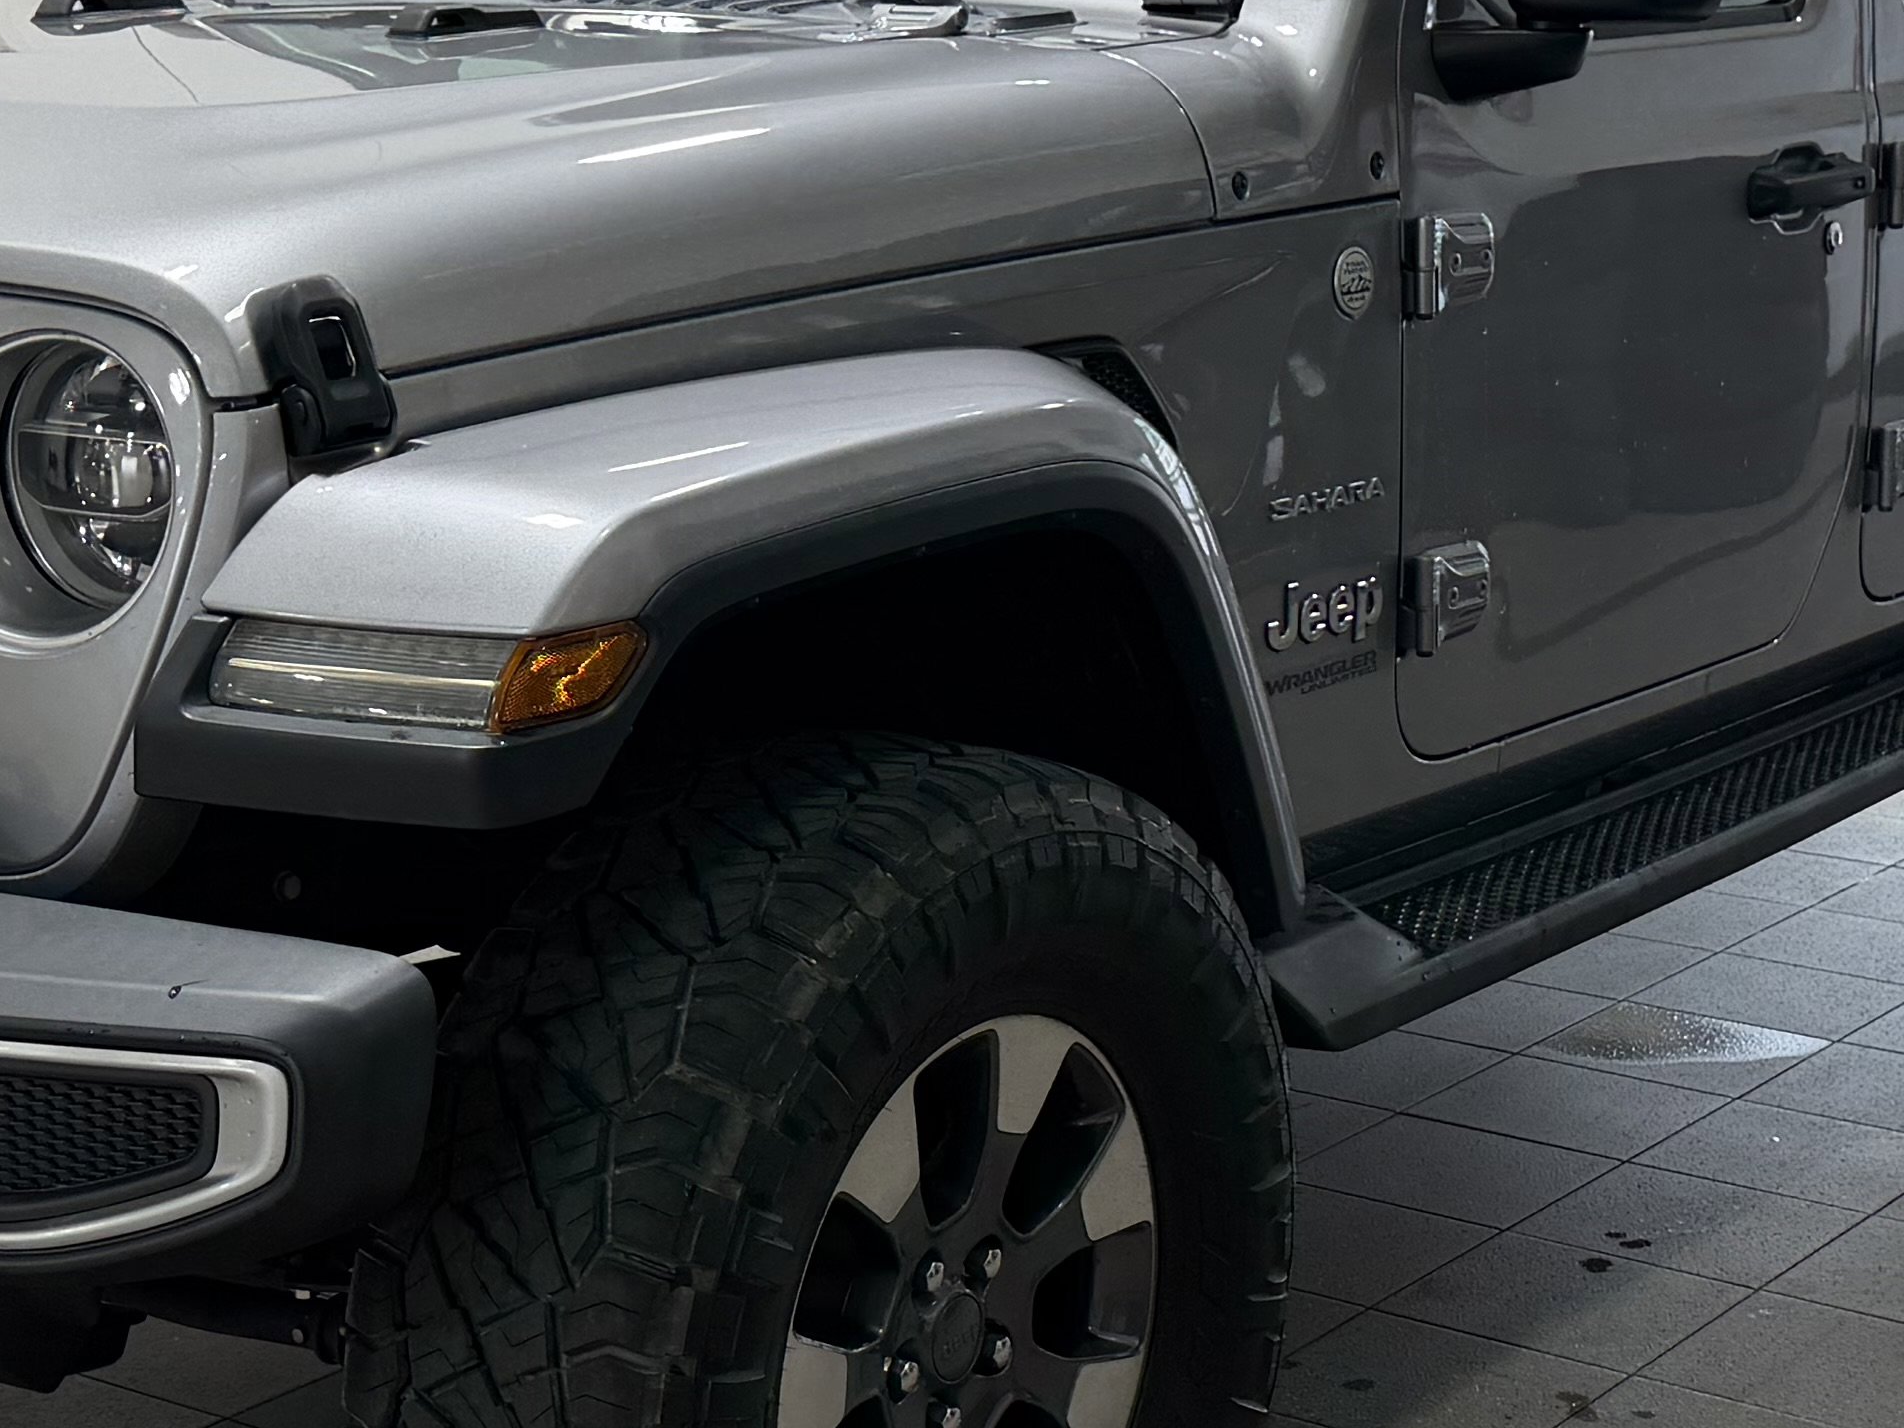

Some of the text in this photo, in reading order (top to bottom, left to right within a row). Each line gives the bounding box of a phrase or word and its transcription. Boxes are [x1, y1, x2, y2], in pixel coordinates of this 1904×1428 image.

[1269, 476, 1385, 521] SAHARA
[1265, 576, 1383, 652] Jeep
[1264, 649, 1377, 696] WRANGLER
